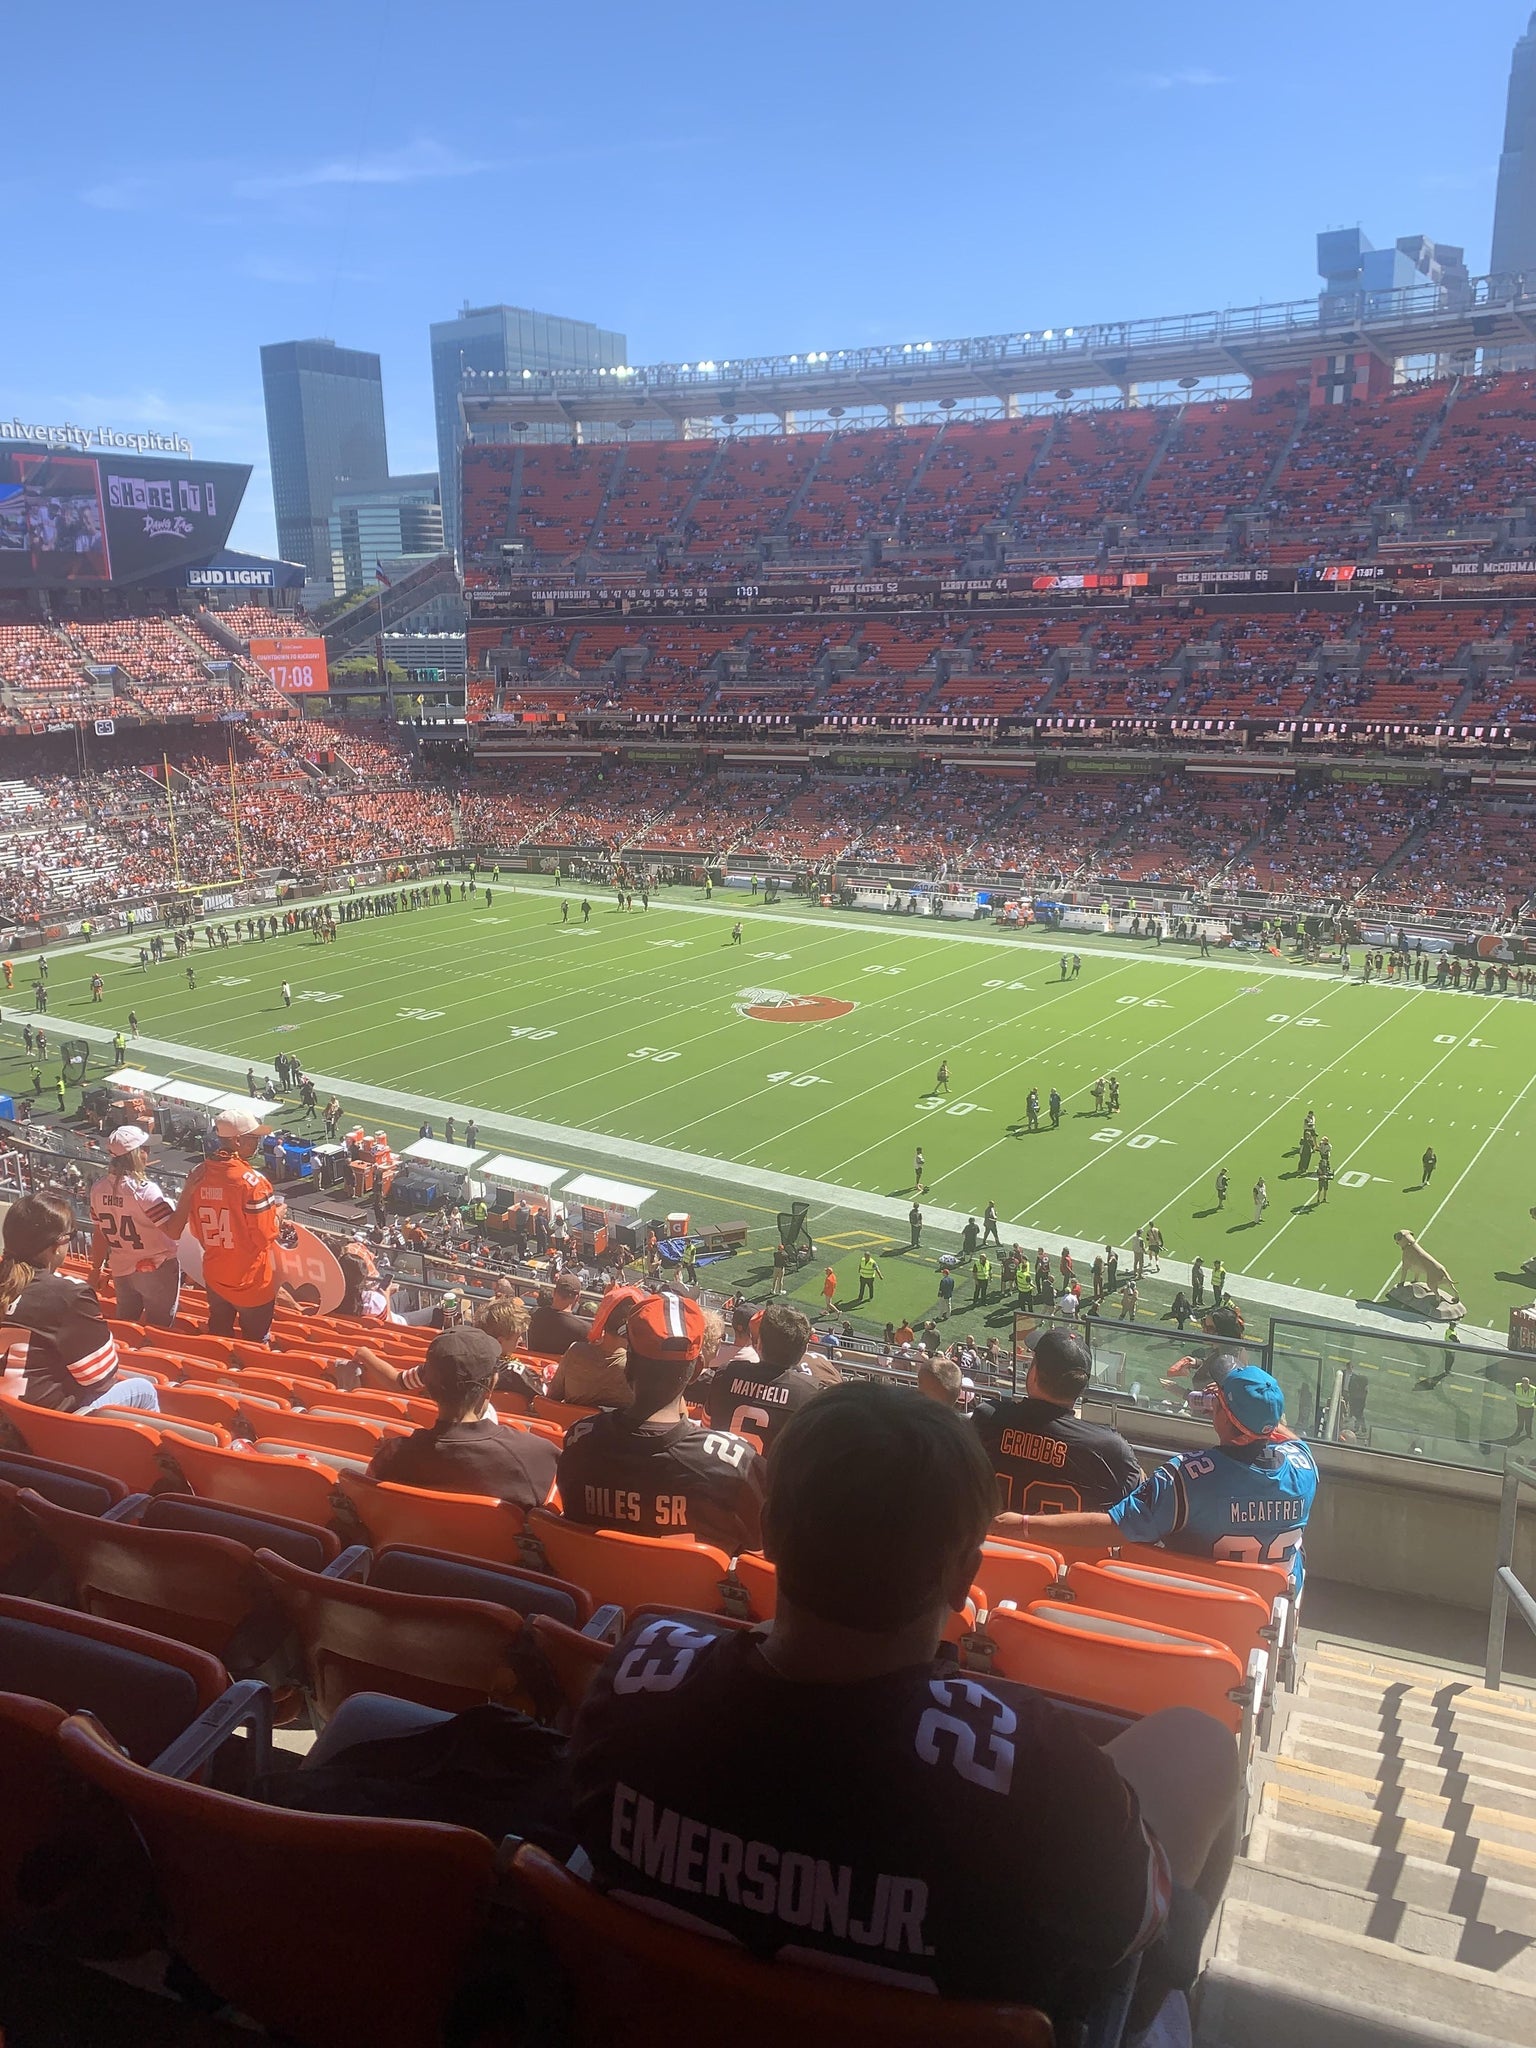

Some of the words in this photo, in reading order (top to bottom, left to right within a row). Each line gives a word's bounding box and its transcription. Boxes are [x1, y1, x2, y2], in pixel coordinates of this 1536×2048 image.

[0, 417, 92, 449] niversity
[97, 425, 190, 454] Hospitals
[190, 571, 224, 584] BUD
[226, 571, 271, 584] LIGHT
[1177, 573, 1200, 582] GENE
[1201, 571, 1251, 581] HICKERSON
[1255, 570, 1268, 580] 66
[1452, 563, 1478, 574] MIKE
[531, 591, 591, 600] CHAMPIONSHIPS
[611, 590, 622, 598] '47
[653, 589, 665, 597] '50
[667, 588, 679, 597] '54
[682, 588, 693, 597] '55
[830, 584, 856, 593] FRANK
[886, 583, 898, 592] 52
[940, 581, 966, 590] LEROY
[967, 580, 993, 589] KELLY
[995, 579, 1007, 589] 44
[269, 665, 313, 687] 17:08
[1115, 995, 1167, 1008] 30
[395, 1007, 446, 1021] 30
[1265, 1013, 1321, 1027] 20
[627, 1046, 682, 1062] 50
[766, 1070, 821, 1087] 40
[914, 1096, 978, 1116] 30
[1088, 1127, 1160, 1150] 20
[98, 1212, 144, 1250] 24
[199, 1206, 235, 1250] 24
[730, 1378, 790, 1405] MAYFIELD
[728, 1404, 771, 1456] 6
[1000, 1428, 1068, 1469] CRIBBS
[655, 1495, 687, 1525] SR
[1231, 1499, 1306, 1523] McCAFFREY
[613, 1619, 717, 1695] 23
[915, 1678, 1018, 1796] 23
[610, 1781, 852, 1939] EMERSON
[849, 1872, 936, 1957] JR.
